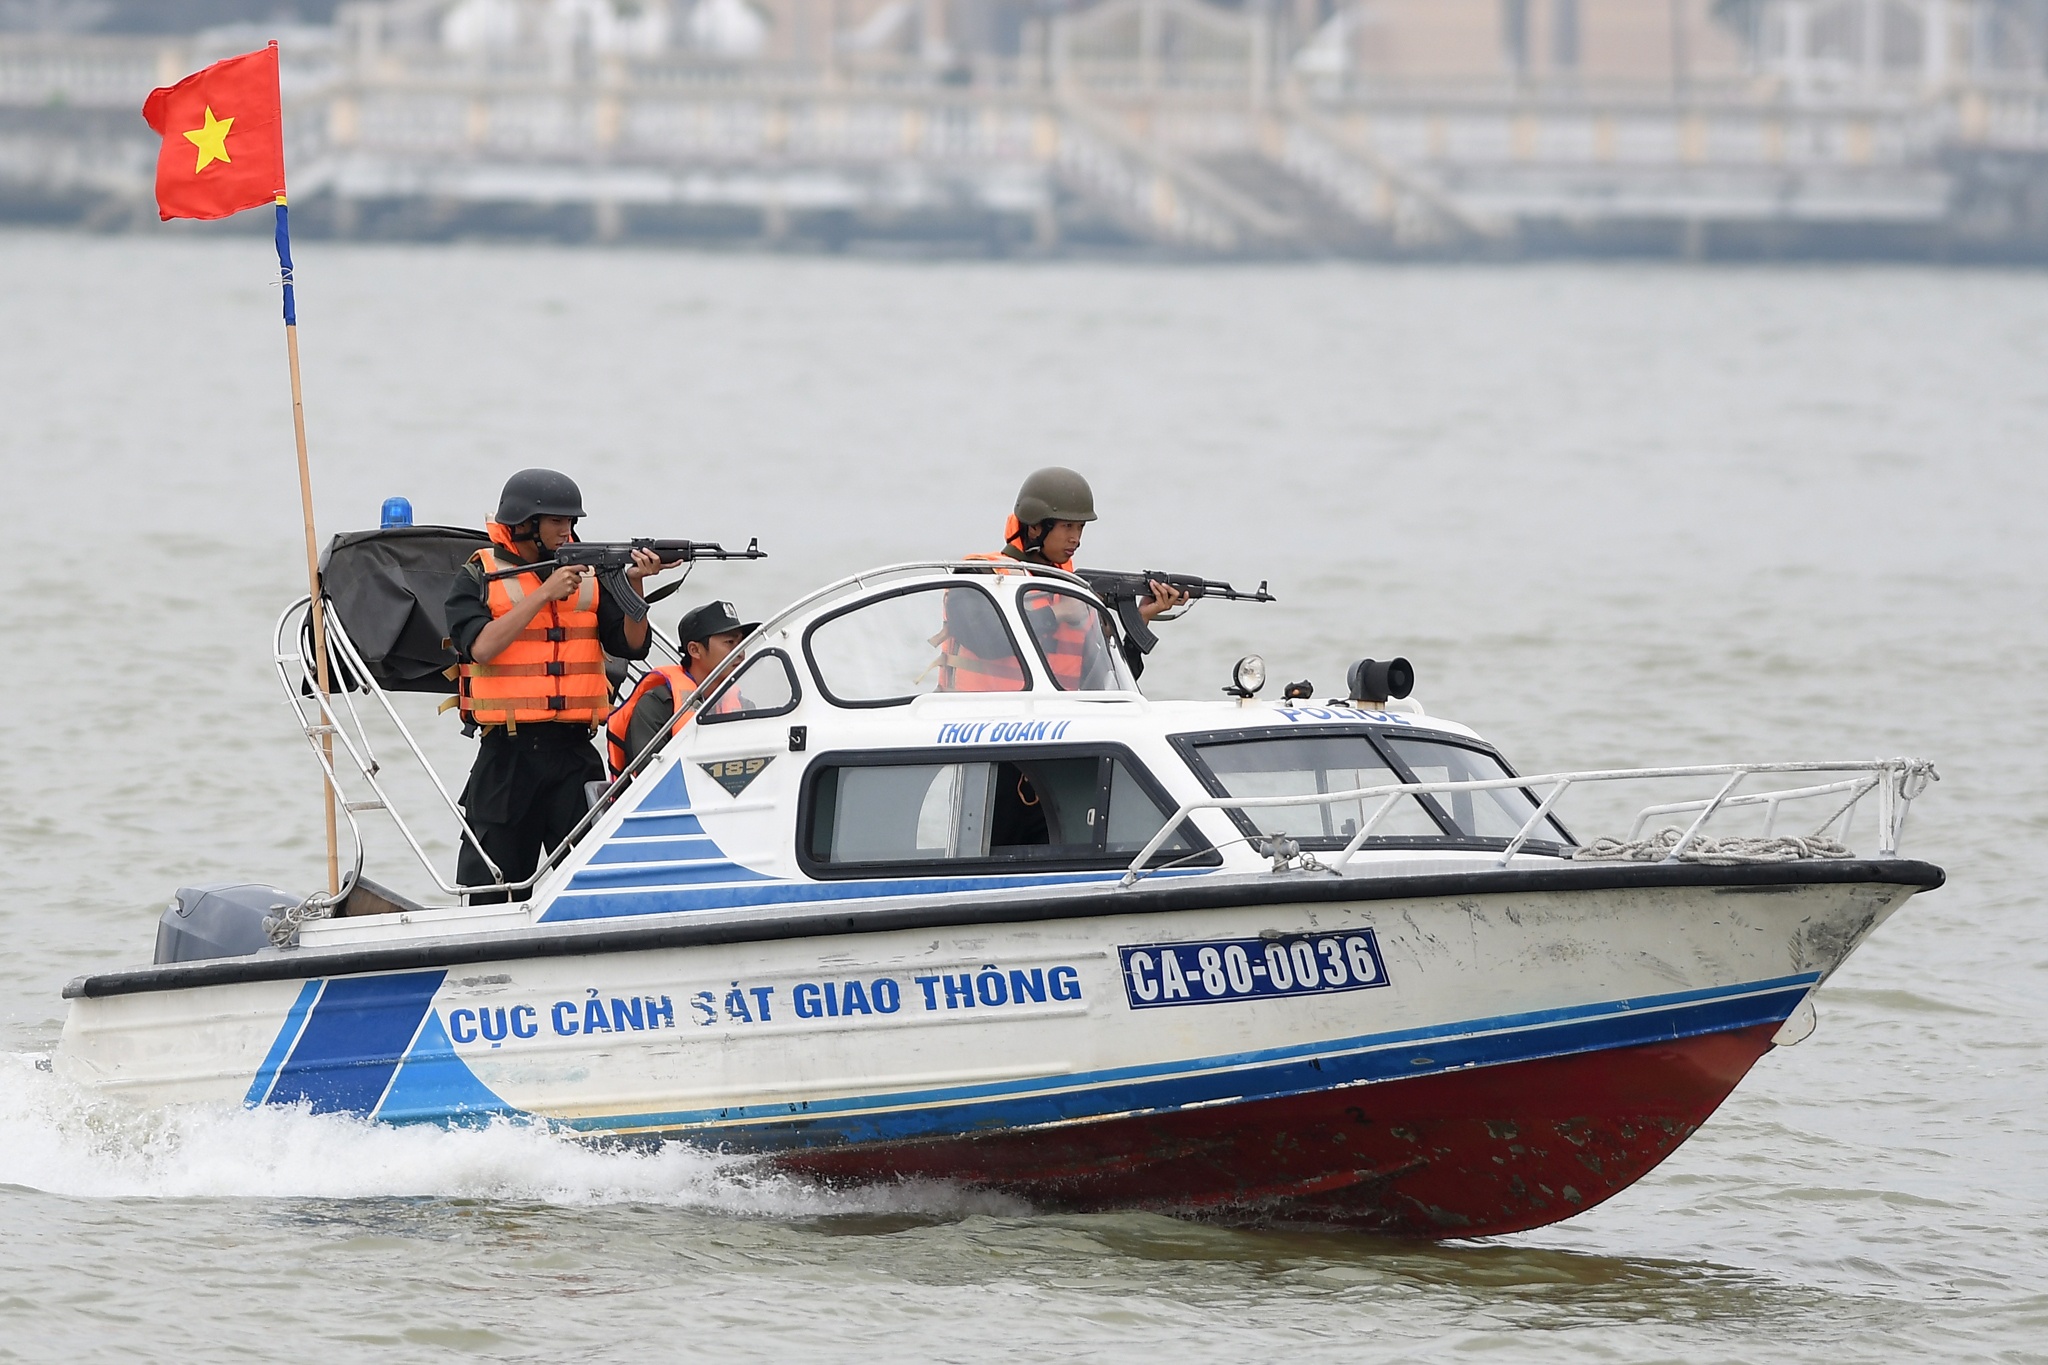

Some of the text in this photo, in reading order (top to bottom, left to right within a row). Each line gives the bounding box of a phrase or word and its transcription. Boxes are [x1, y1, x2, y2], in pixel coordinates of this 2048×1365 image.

[1128, 936, 1377, 1001] CA-80-0036
[449, 1004, 539, 1048] CỤC
[551, 988, 675, 1036] CẢNH
[792, 978, 901, 1019] GIAO
[914, 964, 1082, 1010] THÔNG
